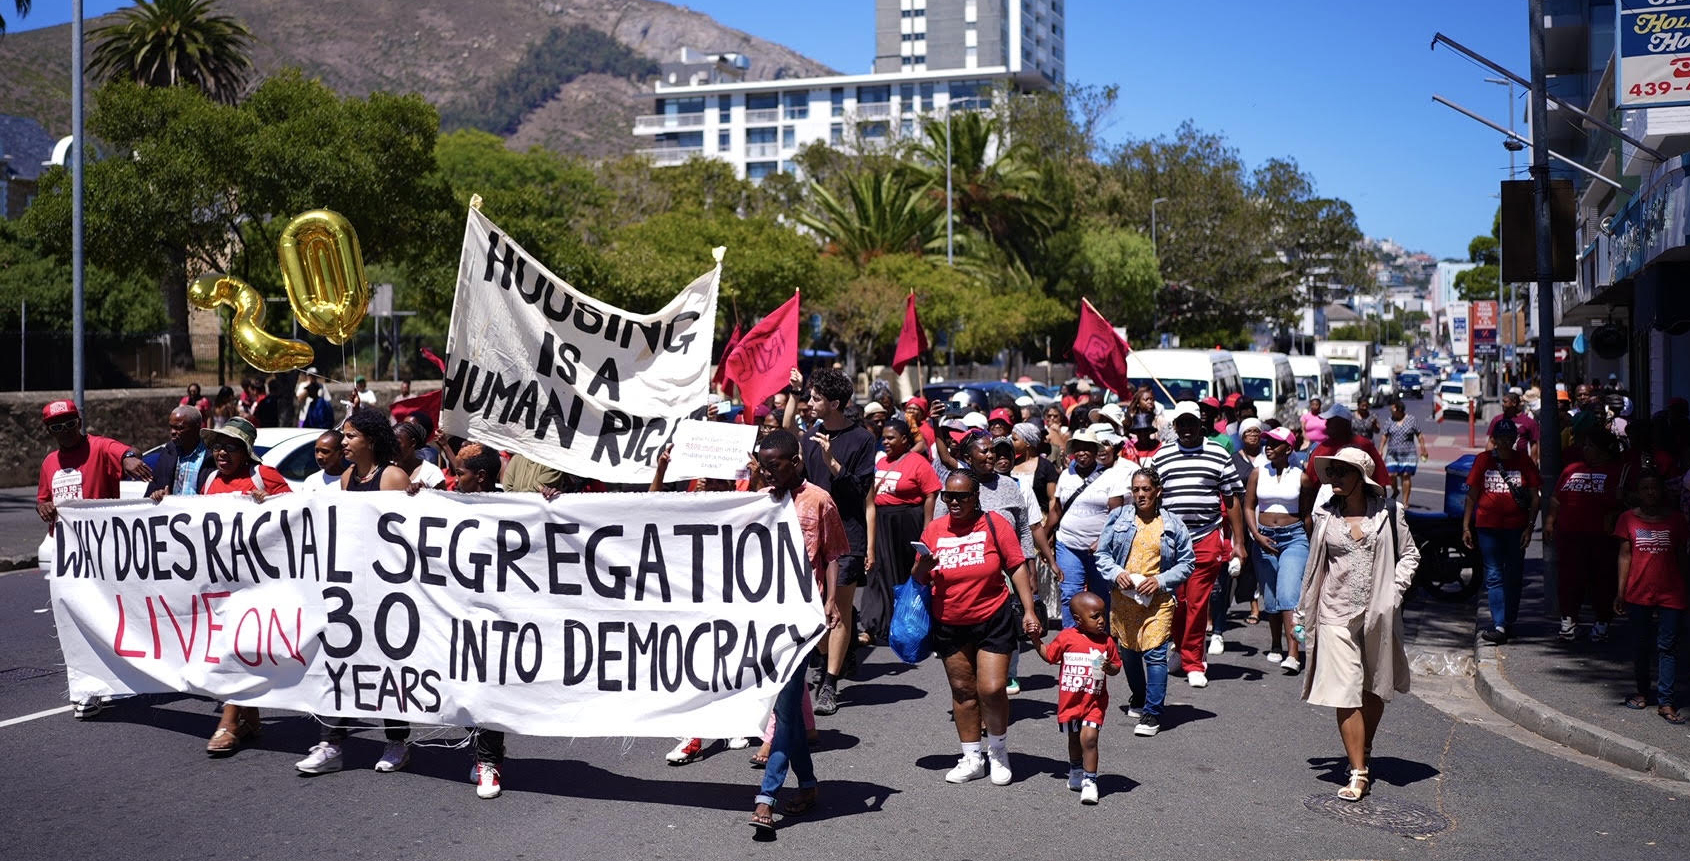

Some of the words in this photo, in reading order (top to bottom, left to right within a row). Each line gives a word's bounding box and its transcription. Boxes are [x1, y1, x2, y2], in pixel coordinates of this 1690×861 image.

[443, 353, 584, 449] HUMAN
[536, 331, 581, 385] IS
[587, 357, 620, 402] A
[55, 520, 107, 580] WHY
[112, 513, 198, 582] DOES
[202, 505, 353, 583] RACIAL
[373, 512, 814, 604] SEGREGATION
[114, 591, 231, 663] LIVE
[234, 607, 307, 667] ON
[317, 586, 421, 661] 30
[449, 617, 543, 686] INTO
[563, 619, 827, 693] DEMOCRACY
[1063, 665, 1086, 675] LAND
[325, 660, 442, 714] YEARS
